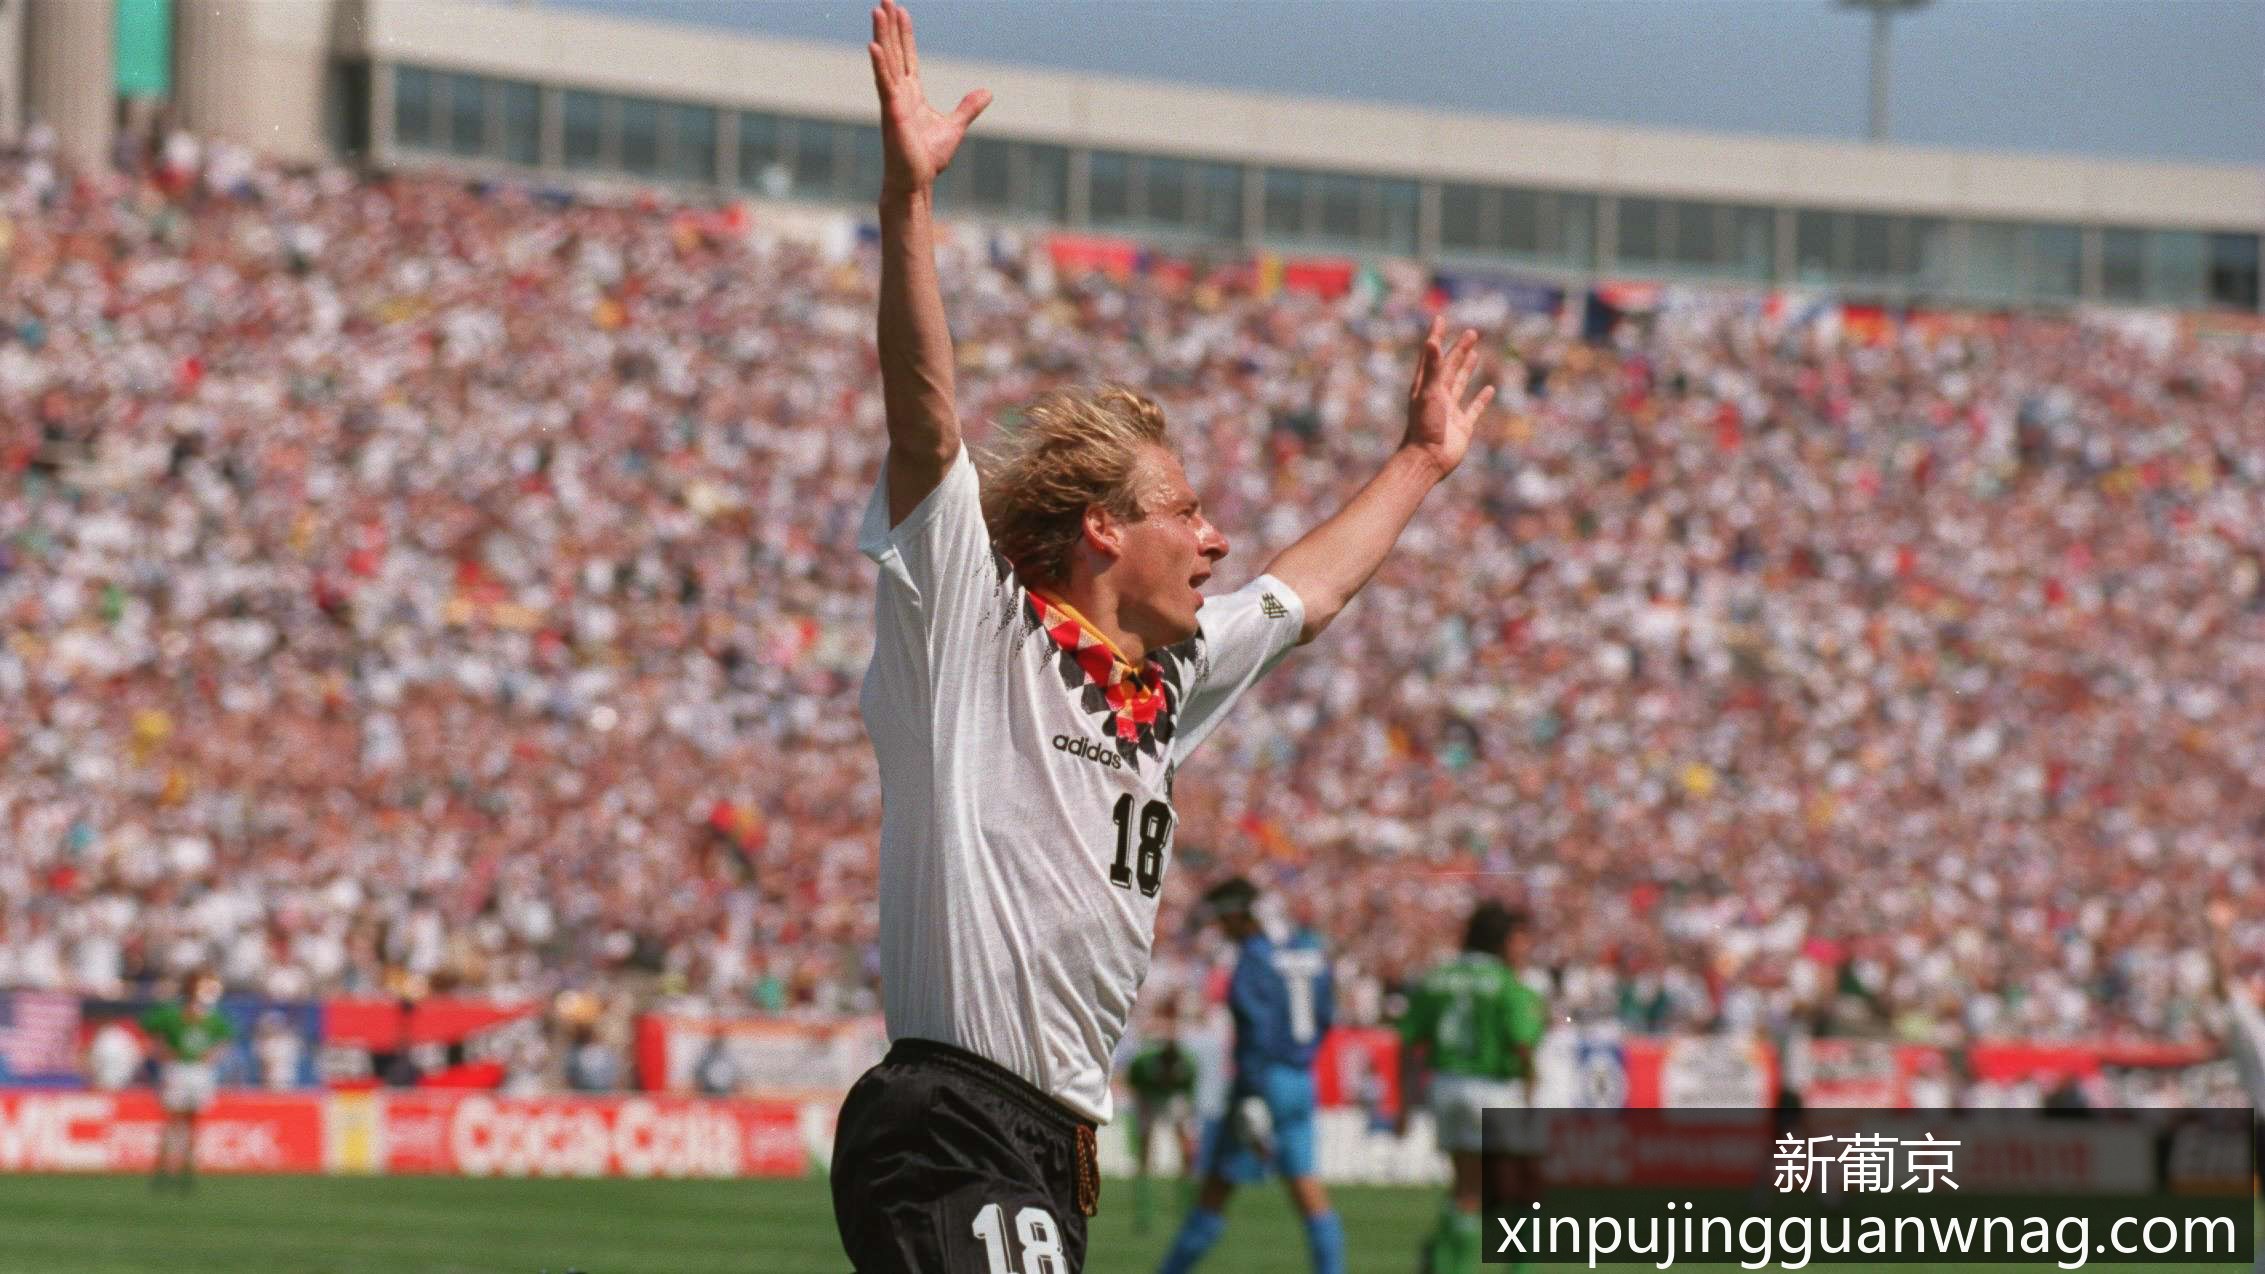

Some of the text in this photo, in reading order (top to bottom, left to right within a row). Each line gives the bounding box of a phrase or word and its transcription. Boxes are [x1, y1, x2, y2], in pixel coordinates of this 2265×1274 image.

[1052, 734, 1122, 769] adidas
[1110, 792, 1172, 898] 18
[972, 1203, 1068, 1274] 18
